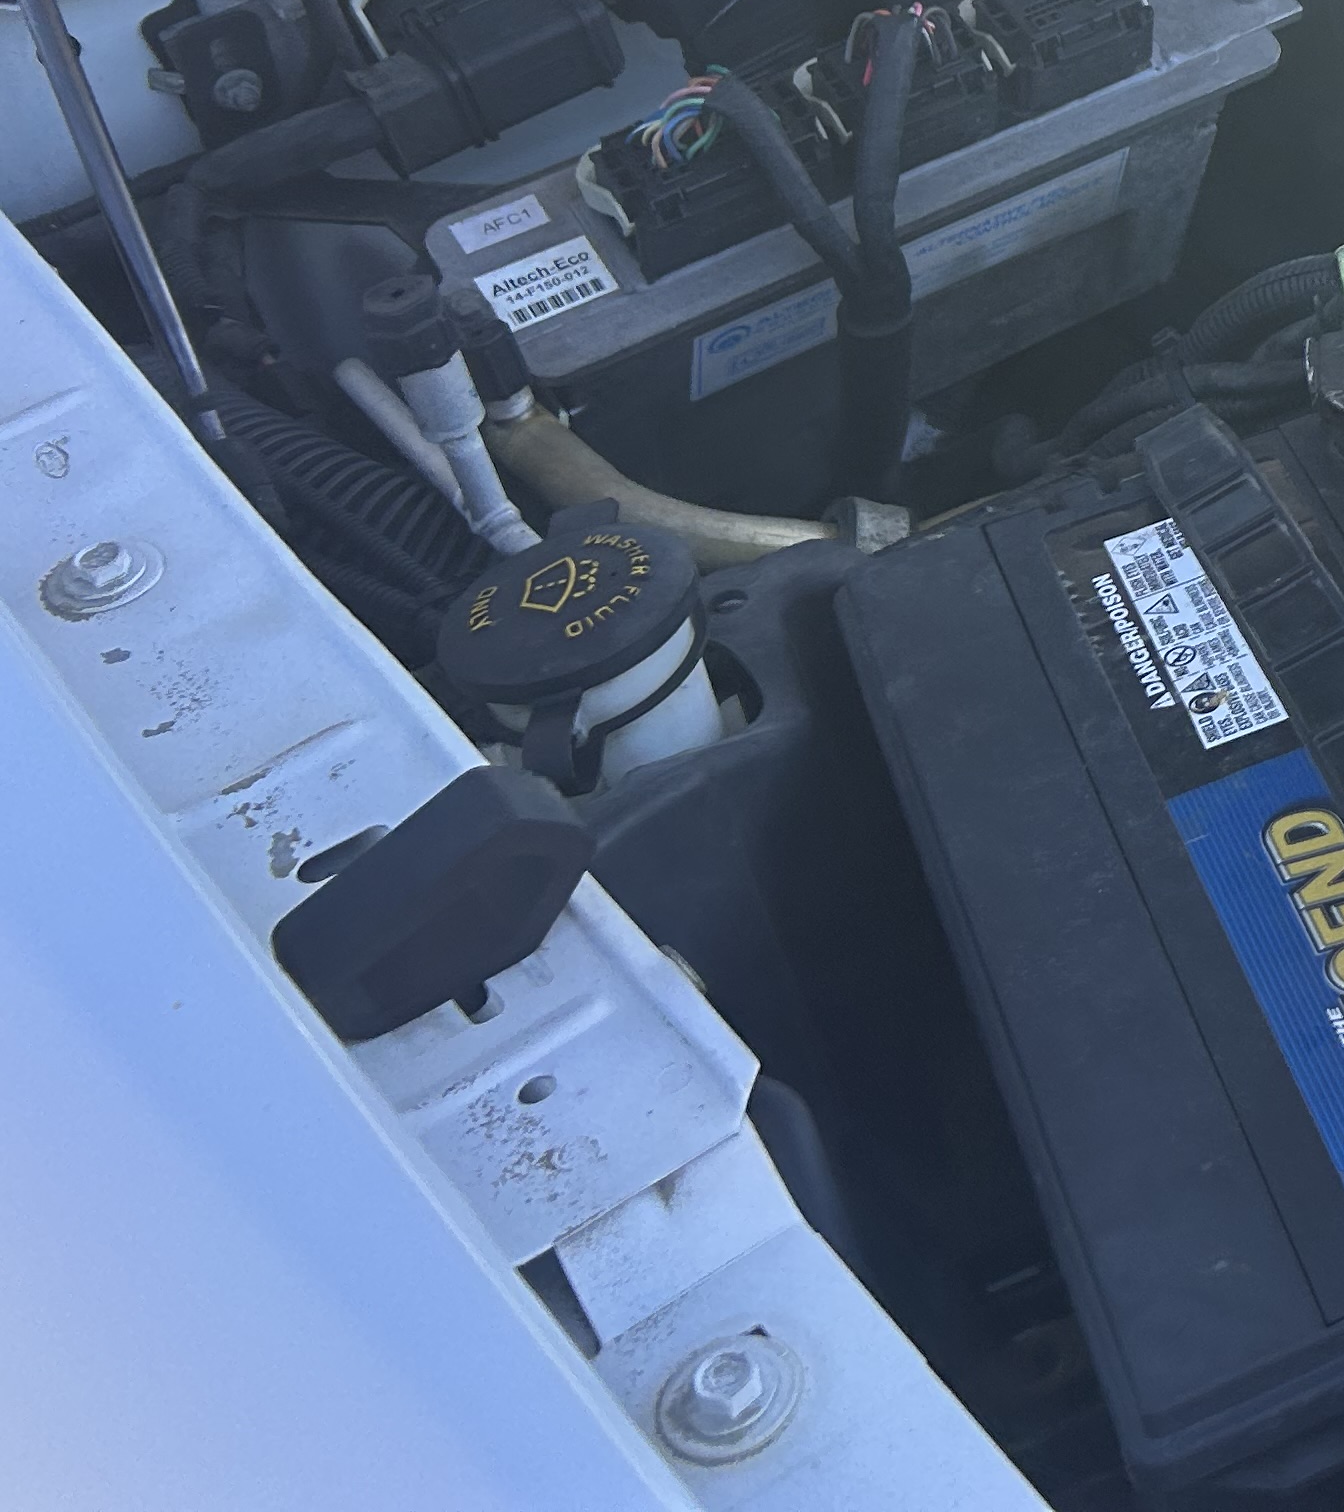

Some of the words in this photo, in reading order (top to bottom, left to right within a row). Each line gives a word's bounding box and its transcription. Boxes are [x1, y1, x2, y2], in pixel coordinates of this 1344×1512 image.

[480, 207, 530, 234] AFC1
[489, 248, 590, 297] Altech-Eco
[504, 264, 589, 305] 14-F150-012
[583, 534, 650, 576] WASHER
[468, 586, 498, 632] ONLY
[564, 585, 641, 639] FLUID
[1090, 571, 1167, 697] DANGER/POISON
